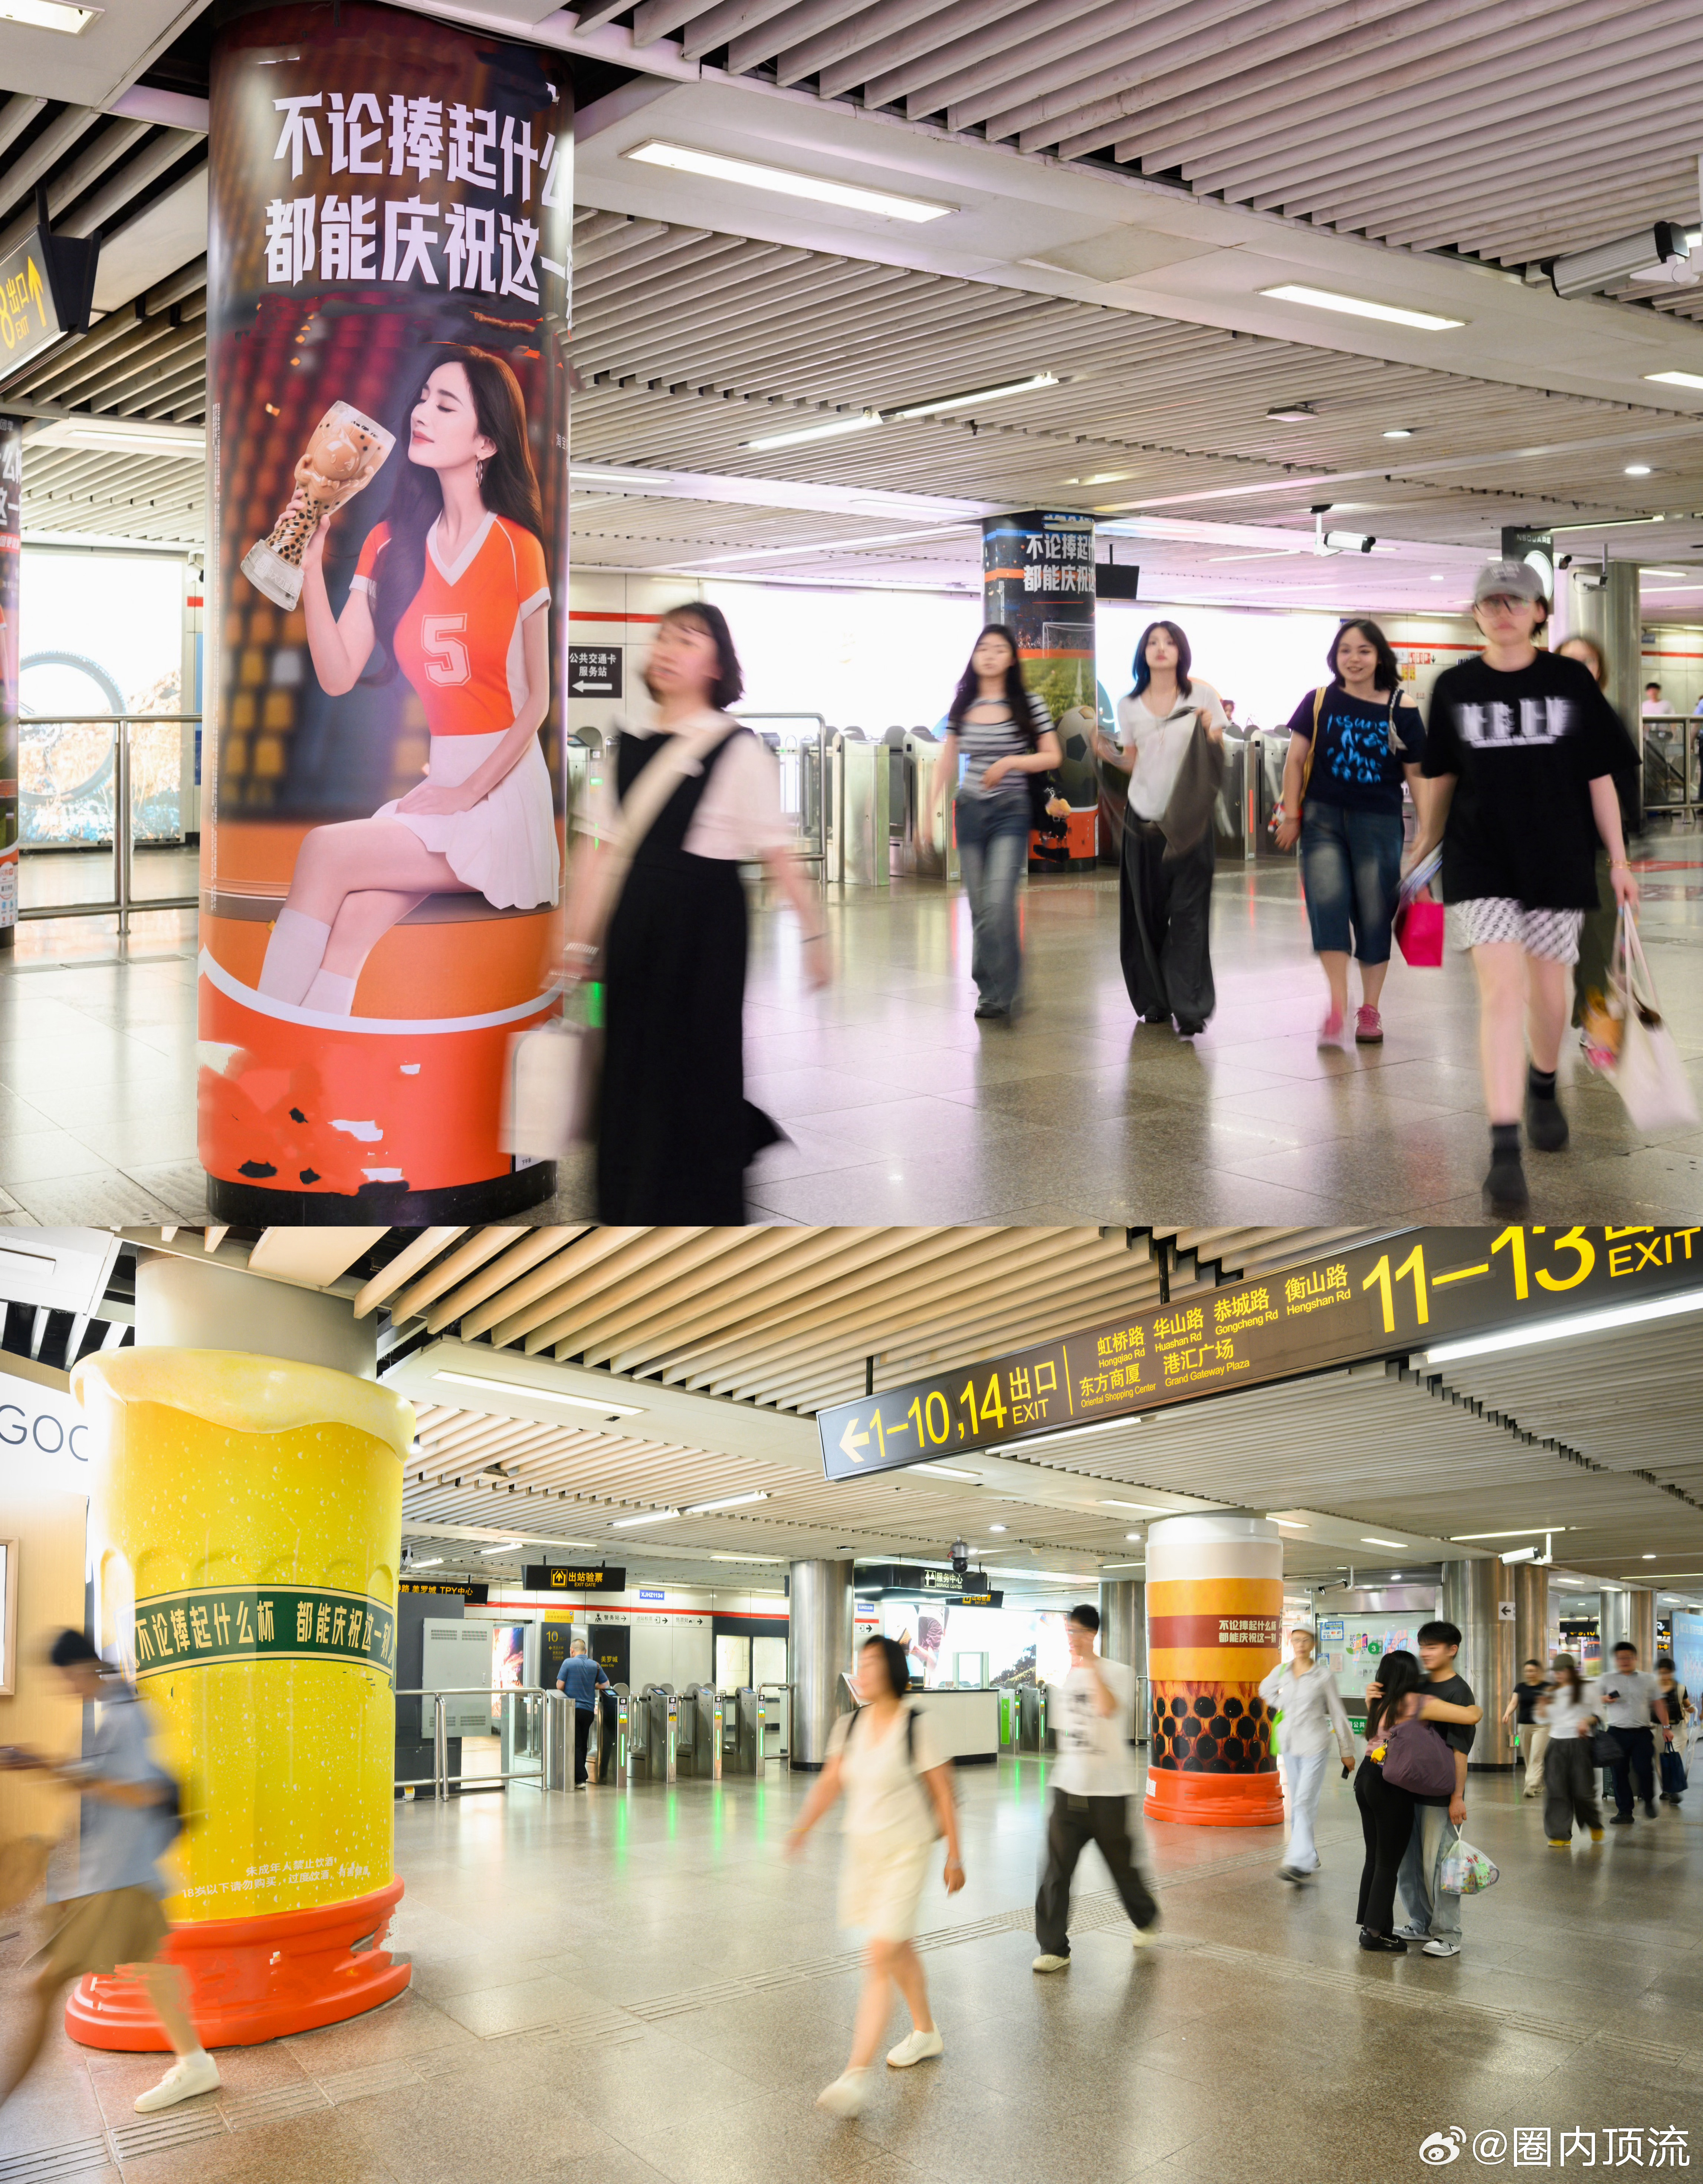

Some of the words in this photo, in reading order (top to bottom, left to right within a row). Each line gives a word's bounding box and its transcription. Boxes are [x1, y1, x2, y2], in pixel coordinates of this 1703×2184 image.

[6, 272, 29, 315] 出口
[15, 315, 30, 340] EXIT
[421, 613, 471, 687] 5
[569, 653, 617, 665] 公共交通卡
[579, 666, 607, 677] 服务站
[1608, 1226, 1701, 1278] EXIT
[1097, 1325, 1145, 1356] 虹桥路
[1153, 1307, 1204, 1340] 华山路
[1214, 1287, 1270, 1323] 恭城路
[1284, 1263, 1348, 1303] 衡山路
[1286, 1295, 1335, 1316] Hengshan
[1336, 1288, 1351, 1302] Rd
[1215, 1315, 1263, 1335] Gongcheng
[1265, 1309, 1279, 1322] Rd
[1155, 1337, 1188, 1352] Huashan
[1190, 1331, 1202, 1343] Rd
[1079, 1363, 1141, 1397] 东方商厦
[1163, 1338, 1234, 1375] 港汇广场
[1099, 1353, 1133, 1368] Hongqiao
[1134, 1347, 1145, 1359] Rd
[1009, 1360, 1058, 1402] 出口
[1165, 1373, 1188, 1387] Grand
[1190, 1366, 1225, 1380] Gateway
[1226, 1360, 1250, 1372] Plaza
[1081, 1395, 1104, 1408] Oriental
[1105, 1389, 1133, 1401] Shopping
[1135, 1383, 1156, 1395] Center
[1012, 1398, 1049, 1425] EXIT
[568, 1572, 603, 1583] 出站验票
[936, 1572, 963, 1584] 服务中心
[411, 1585, 436, 1594] 美罗城
[440, 1586, 473, 1596] TPY中心
[133, 1600, 275, 1661] 不论捧起什么杯
[296, 1600, 392, 1660] 都能庆祝这一刻
[546, 1630, 558, 1643] 10
[1219, 1620, 1276, 1631] 不论捧起什么杯
[1219, 1632, 1276, 1643] 都能庆祝这一刻
[246, 1856, 334, 1877] 未成年人禁止饮酒
